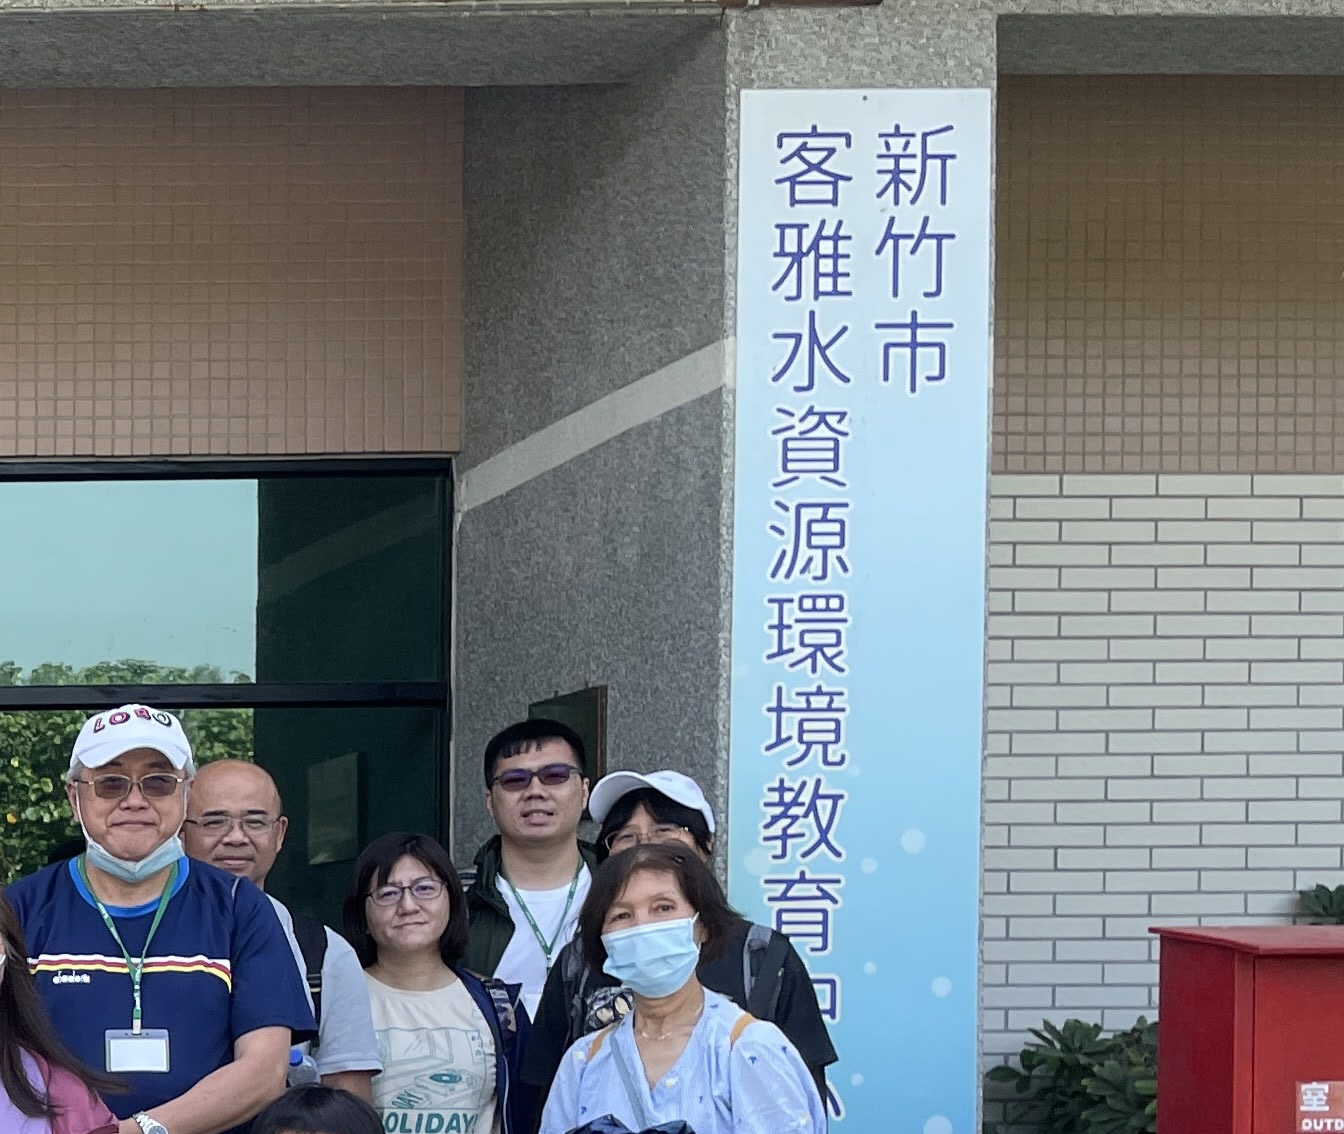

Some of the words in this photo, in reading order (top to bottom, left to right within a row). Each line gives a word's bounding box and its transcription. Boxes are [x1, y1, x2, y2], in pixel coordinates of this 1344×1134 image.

[874, 123, 957, 394] 新竹市
[762, 124, 854, 1118] 客雅水資源環境教育
[382, 1111, 479, 1134] OLIDAY!
